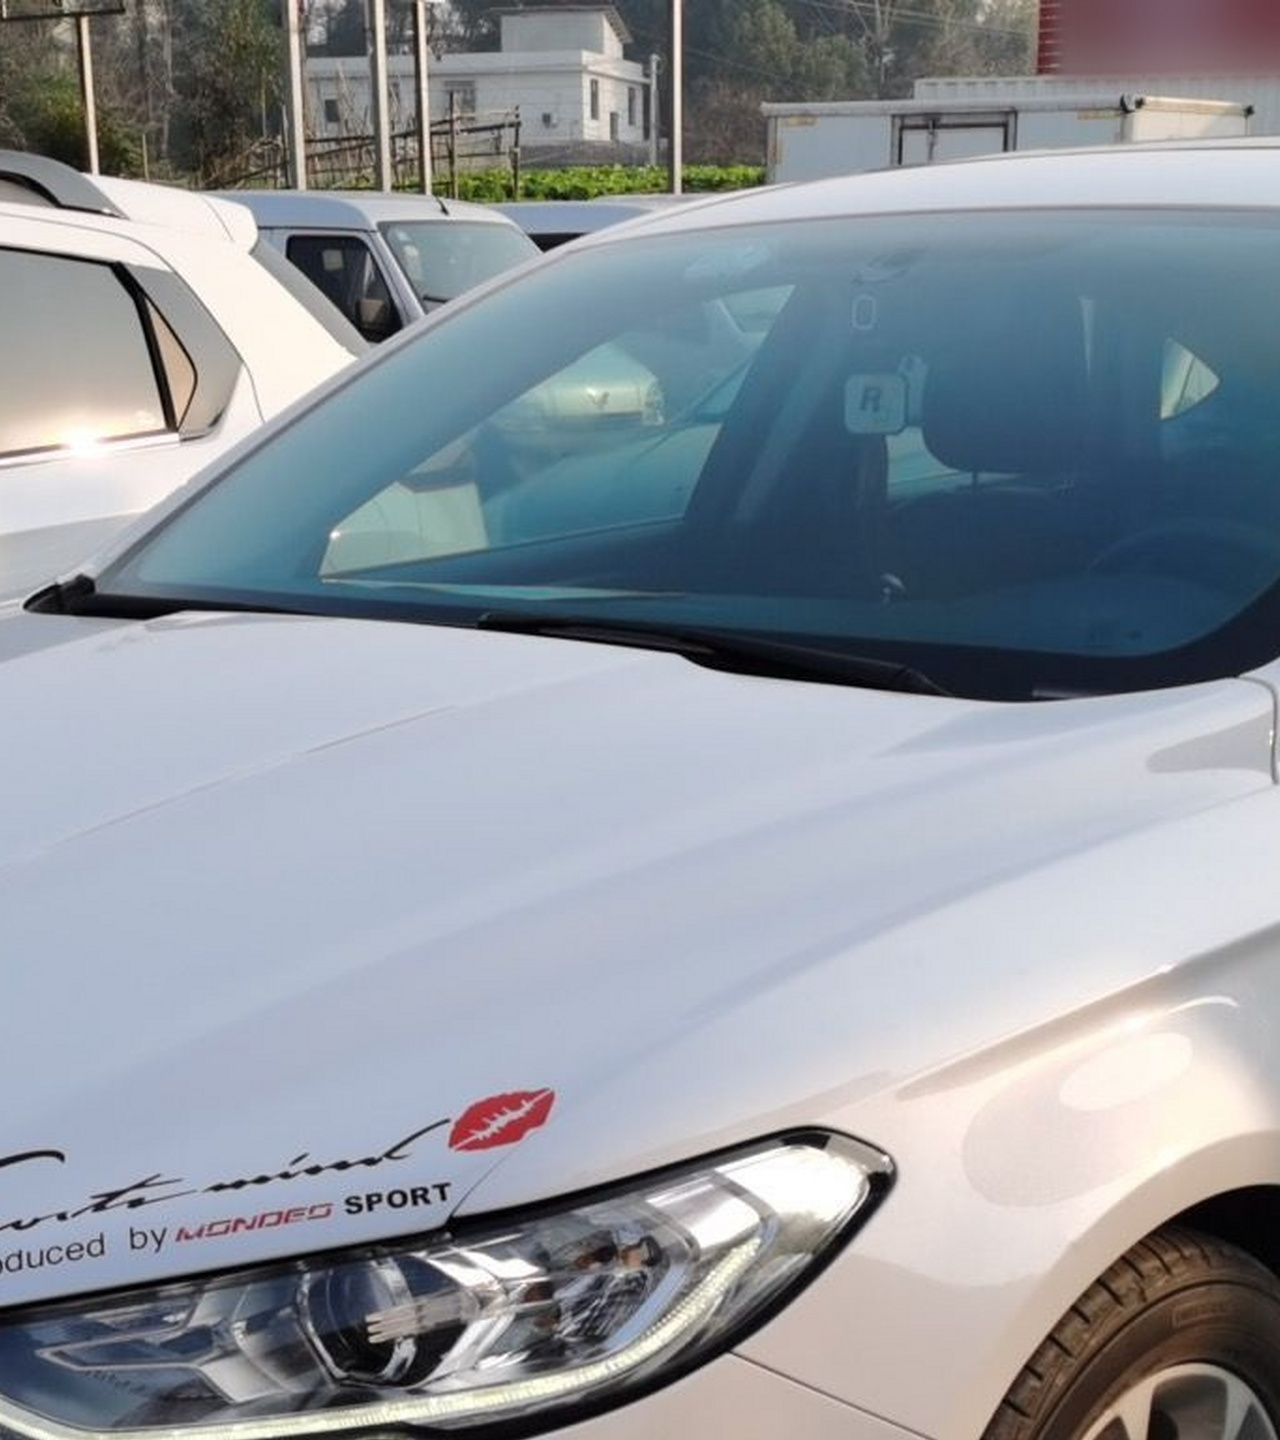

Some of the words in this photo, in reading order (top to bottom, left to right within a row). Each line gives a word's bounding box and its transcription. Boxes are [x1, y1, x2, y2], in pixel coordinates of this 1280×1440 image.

[129, 1226, 167, 1254] by
[174, 1203, 335, 1243] MONDEO
[344, 1182, 451, 1215] SPORT
